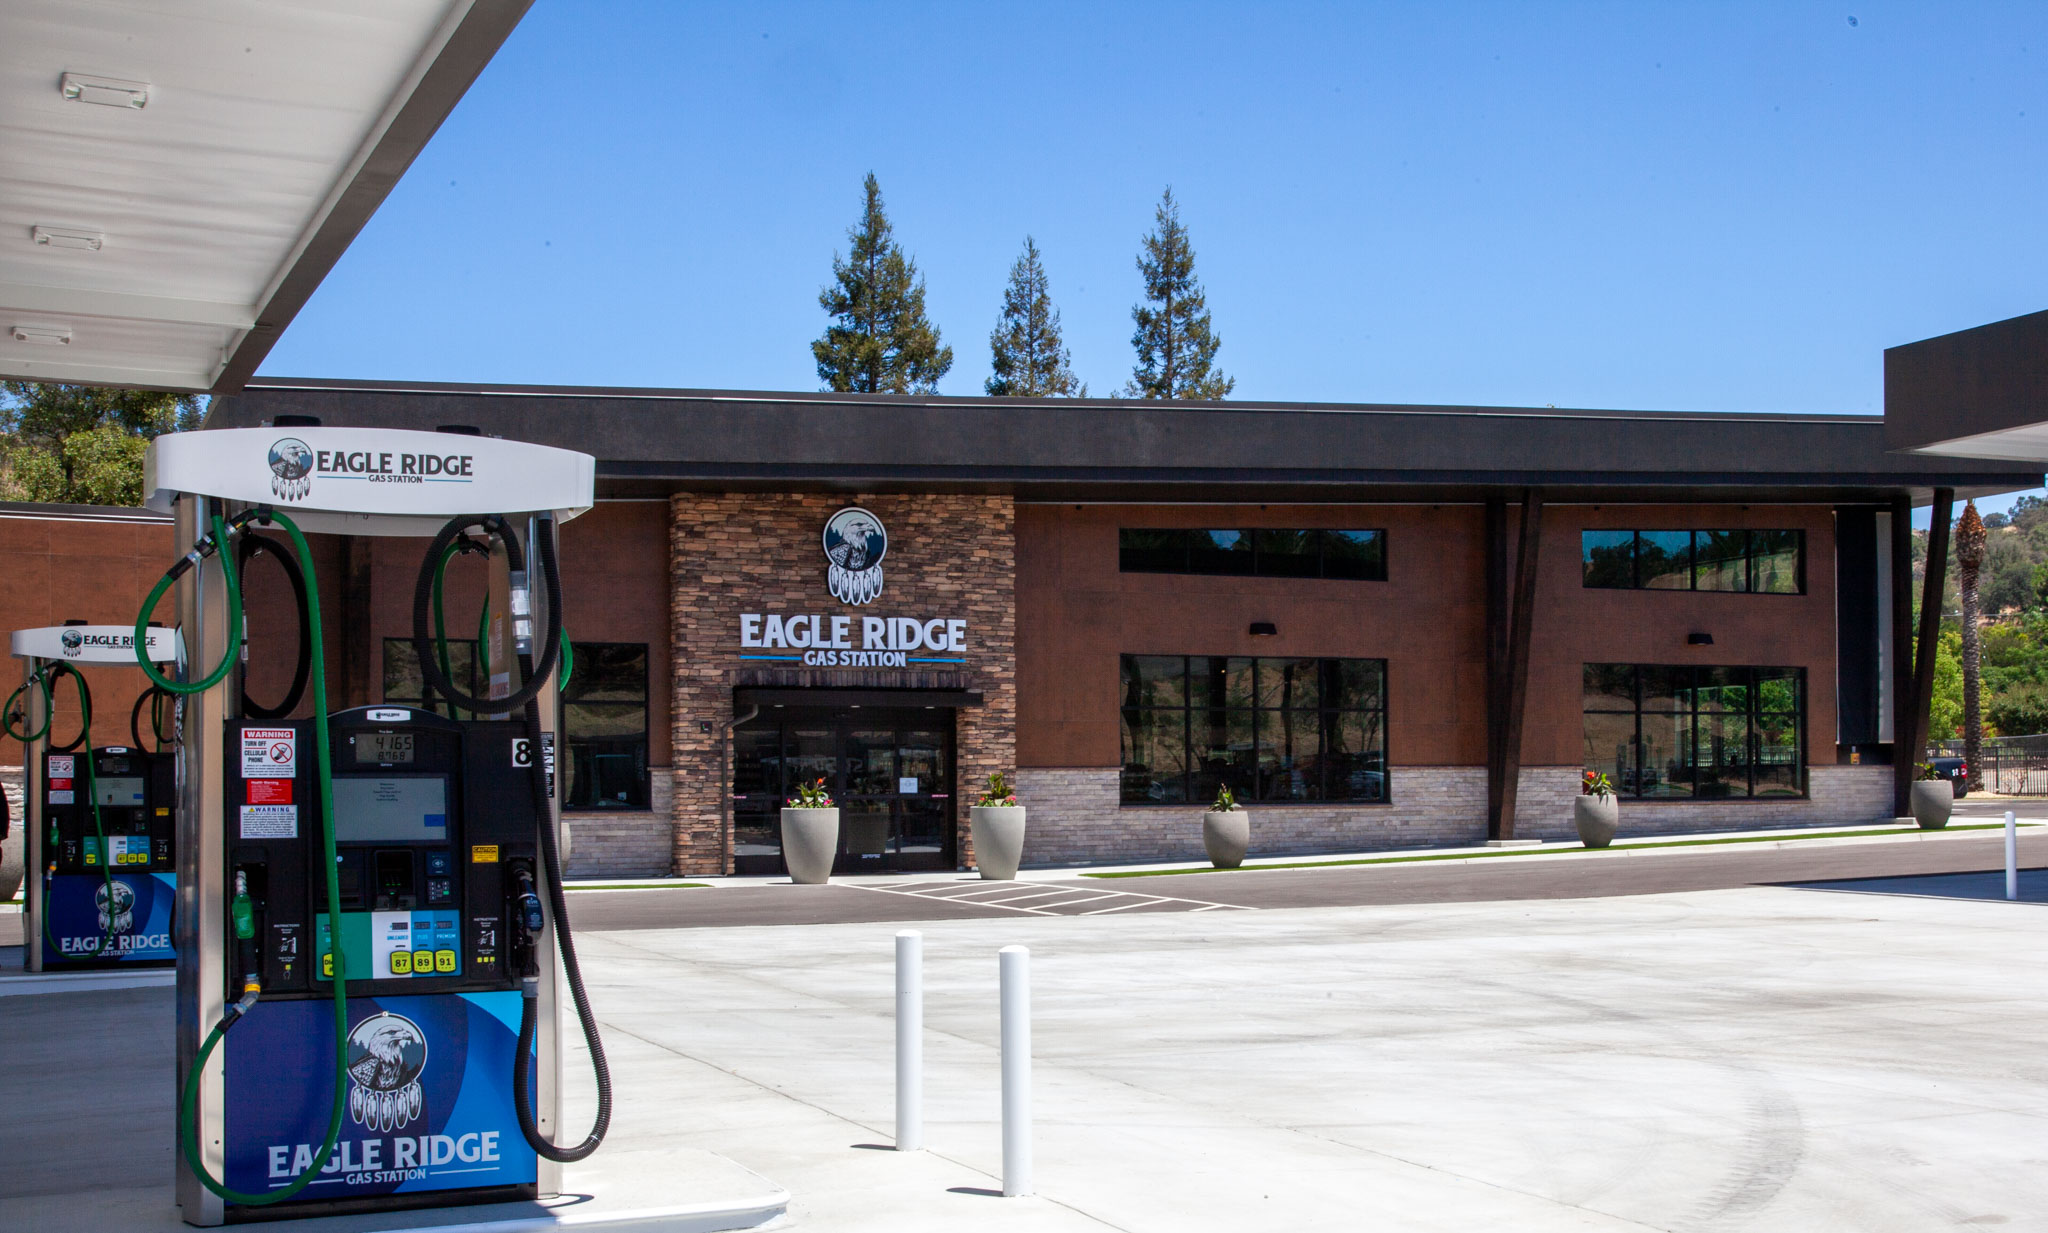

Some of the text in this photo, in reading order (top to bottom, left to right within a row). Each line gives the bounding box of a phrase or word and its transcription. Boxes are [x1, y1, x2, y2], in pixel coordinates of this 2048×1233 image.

[317, 450, 473, 476] EAGLE RIDGE
[368, 474, 423, 483] GAS STATION
[84, 635, 156, 646] EAGLE RIGE
[740, 614, 967, 652] EAGLE RIDGE
[804, 651, 906, 667] GAS STATION
[515, 740, 532, 765] 8
[119, 934, 169, 950] RIDGE
[395, 959, 408, 967] 87
[417, 958, 430, 967] 89
[440, 957, 451, 966] 91
[268, 1131, 500, 1178] EAGLE RIDGE
[346, 1168, 426, 1185] GAS STATION
